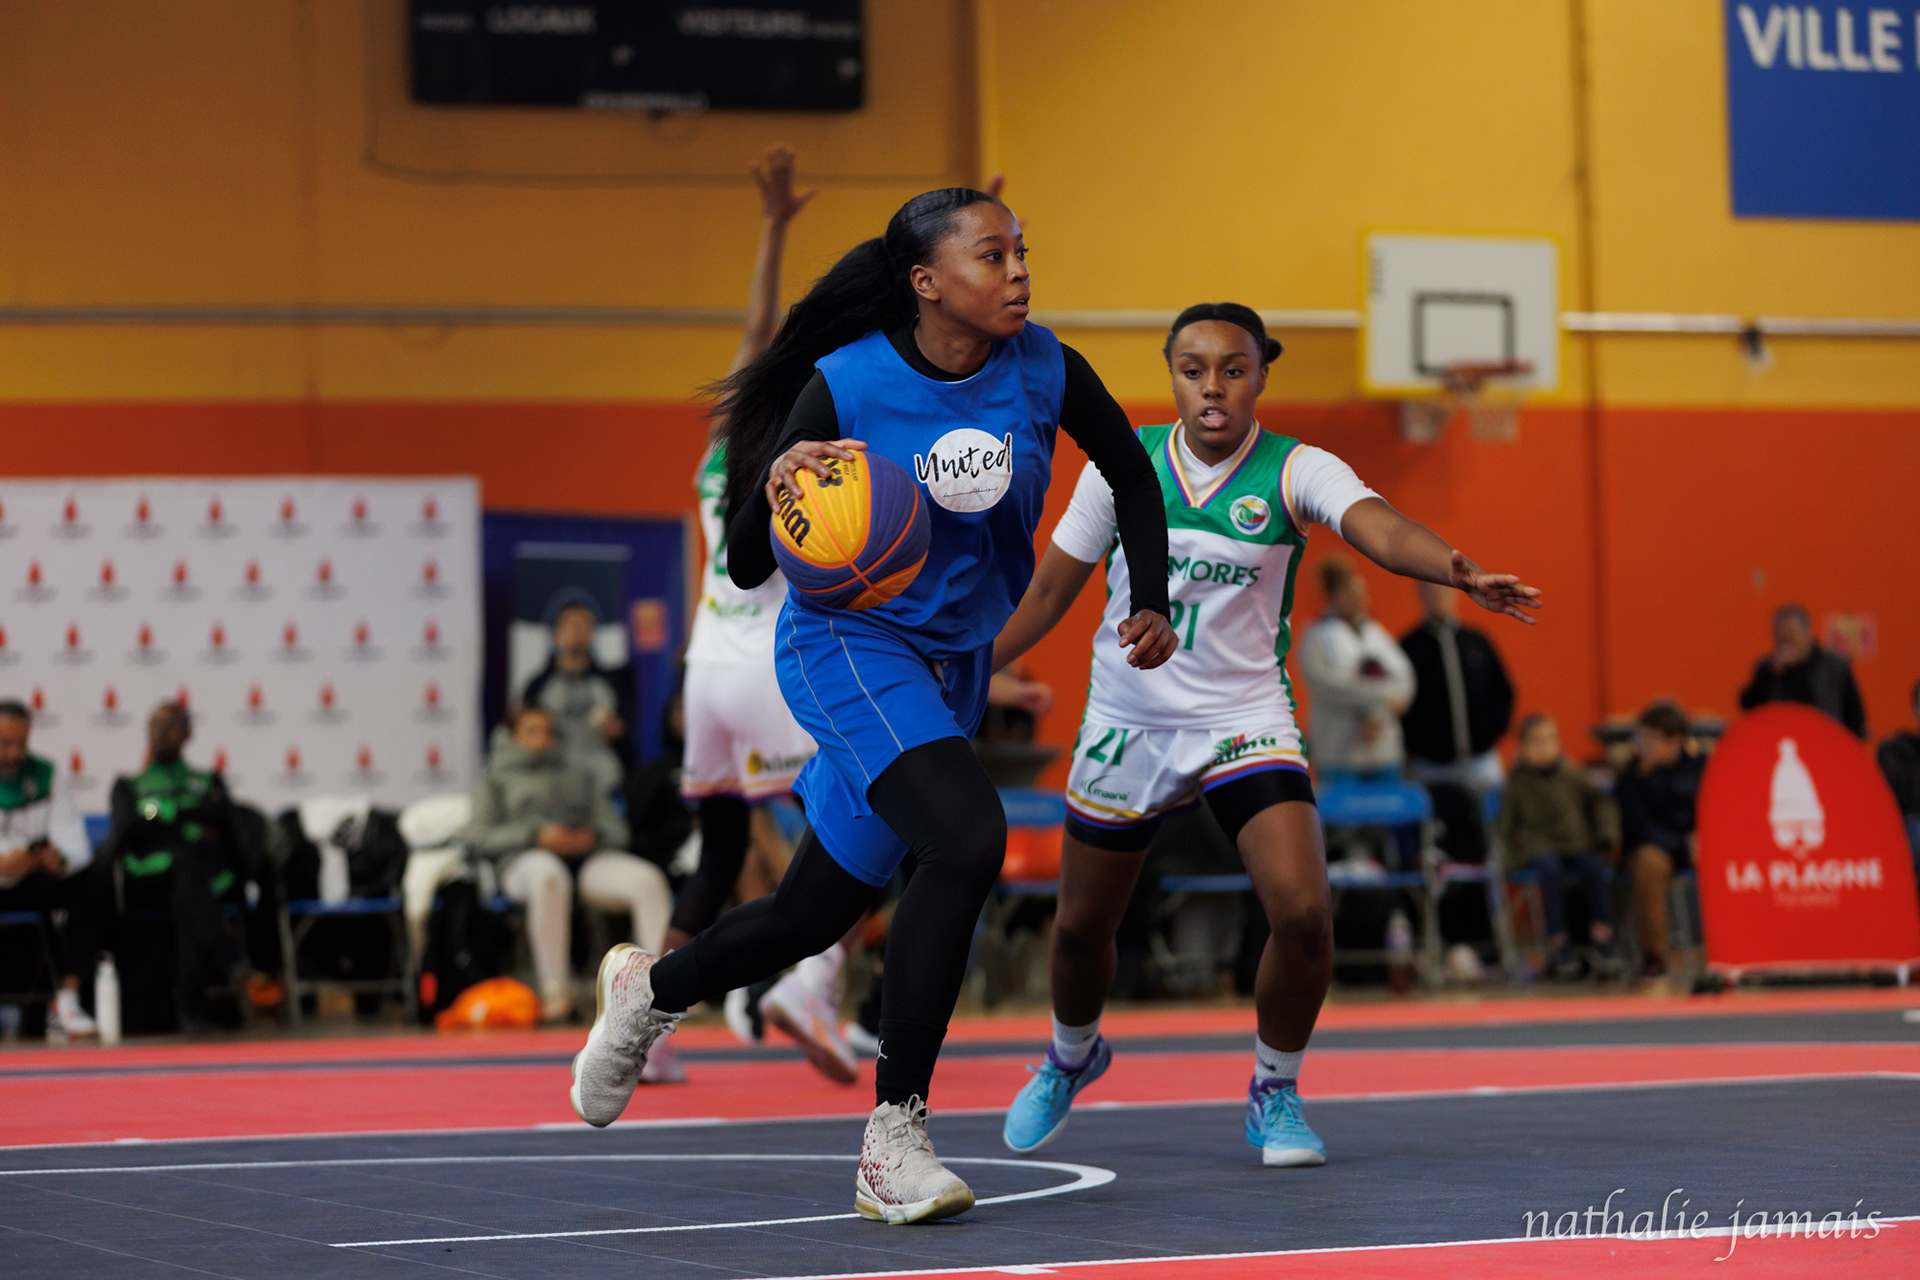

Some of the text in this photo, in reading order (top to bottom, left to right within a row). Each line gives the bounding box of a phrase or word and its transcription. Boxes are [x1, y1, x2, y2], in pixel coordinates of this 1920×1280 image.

[1737, 4, 1903, 73] VILLE
[1086, 729, 1128, 766] 21
[1725, 857, 1883, 891] LA PLAGNE
